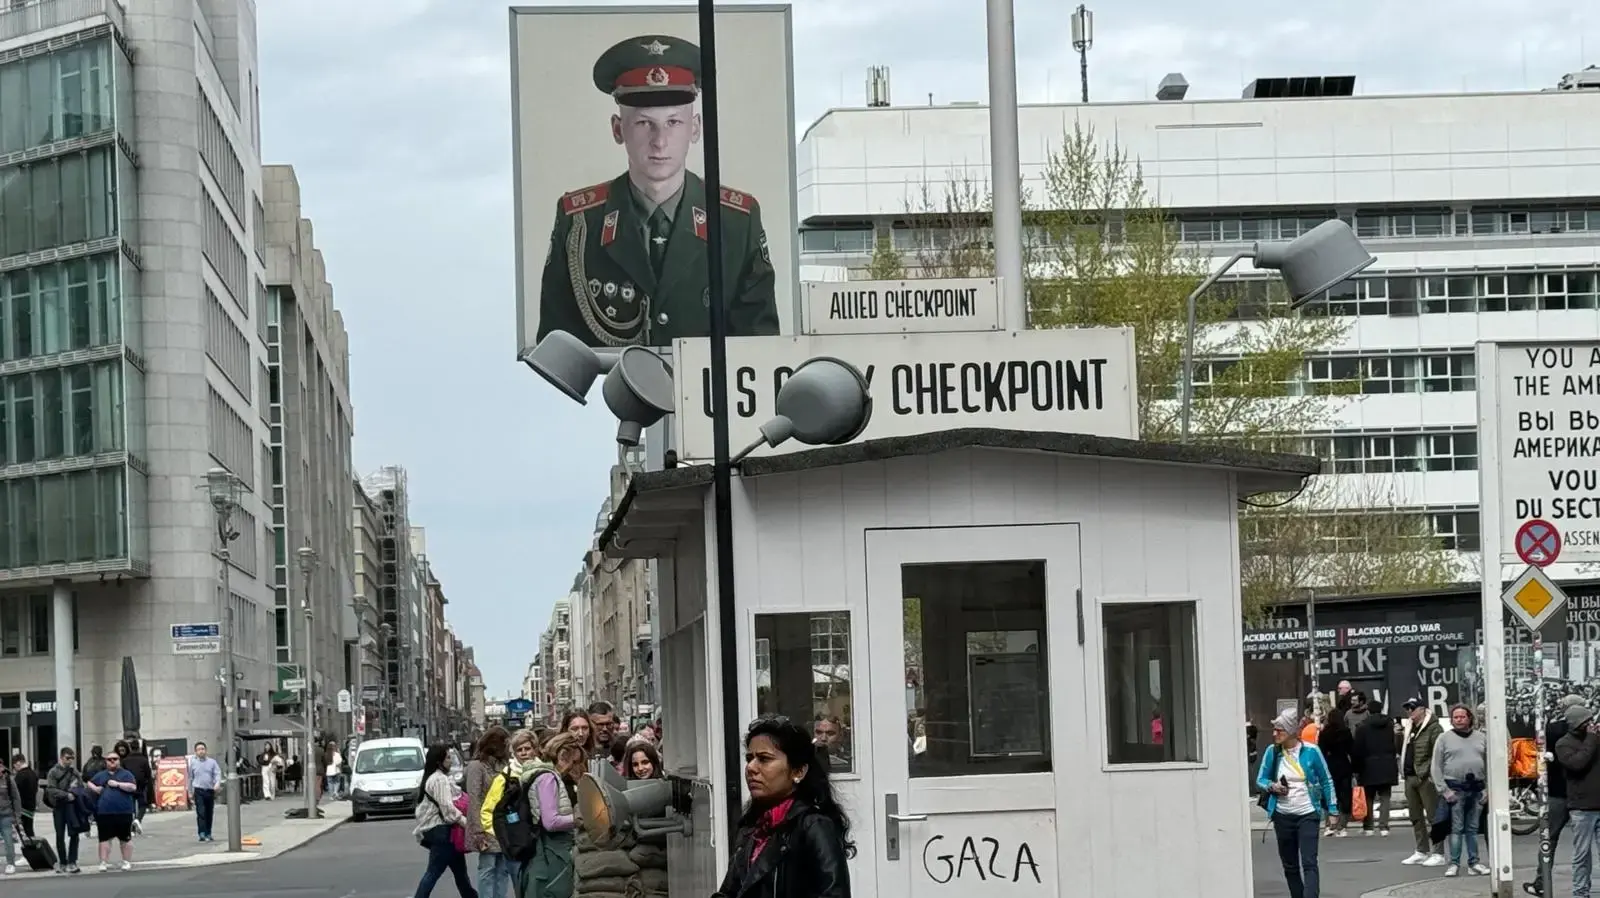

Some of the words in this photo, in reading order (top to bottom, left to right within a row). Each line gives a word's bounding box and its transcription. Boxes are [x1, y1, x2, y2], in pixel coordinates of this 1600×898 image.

[829, 291, 878, 320] ALLIED
[885, 288, 977, 318] CHECKPOINT
[1525, 347, 1573, 368] YOU
[892, 359, 1107, 415] CHECKPOINT
[1513, 375, 1550, 396] THE
[1518, 410, 1554, 431] ВЫ
[1513, 436, 1600, 458] АМЕРИКА
[1548, 469, 1597, 490] VOU
[1516, 498, 1542, 519] DU
[1552, 497, 1600, 519] SECT
[1270, 641, 1309, 650] CHECKPOINT
[1347, 636, 1384, 646] EXHIBITION
[1384, 635, 1393, 644] AT
[1393, 633, 1435, 644] CHECKPOINT
[1435, 632, 1465, 642] CHARLIE
[1278, 630, 1309, 640] KALTER
[1346, 626, 1393, 636] BLACKBOX
[1394, 624, 1418, 634] COLD
[1419, 623, 1441, 632] WAR
[923, 835, 1042, 884] GAZA
